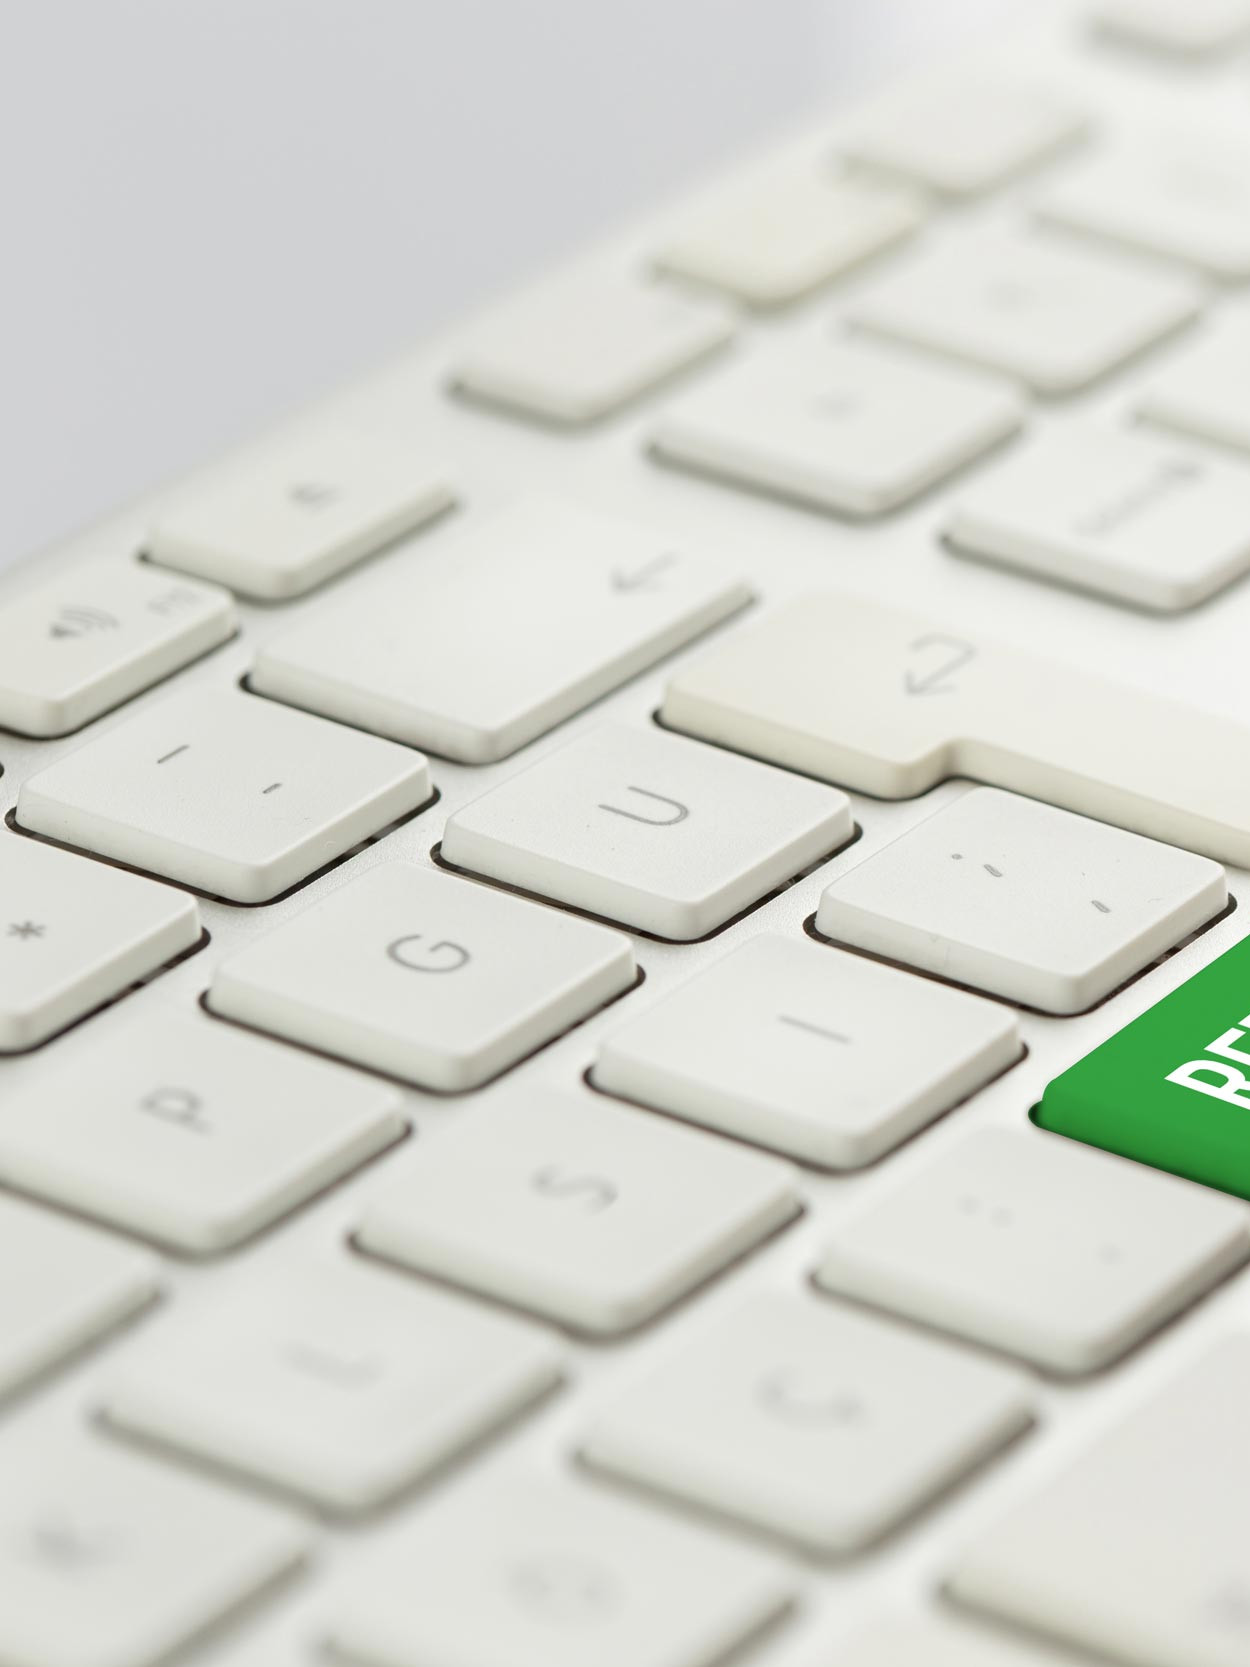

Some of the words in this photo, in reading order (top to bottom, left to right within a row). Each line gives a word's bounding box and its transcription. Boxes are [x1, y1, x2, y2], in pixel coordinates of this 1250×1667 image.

[597, 785, 691, 827] U
[384, 933, 473, 975] G
[138, 1085, 213, 1135] P
[529, 1164, 619, 1213] S
